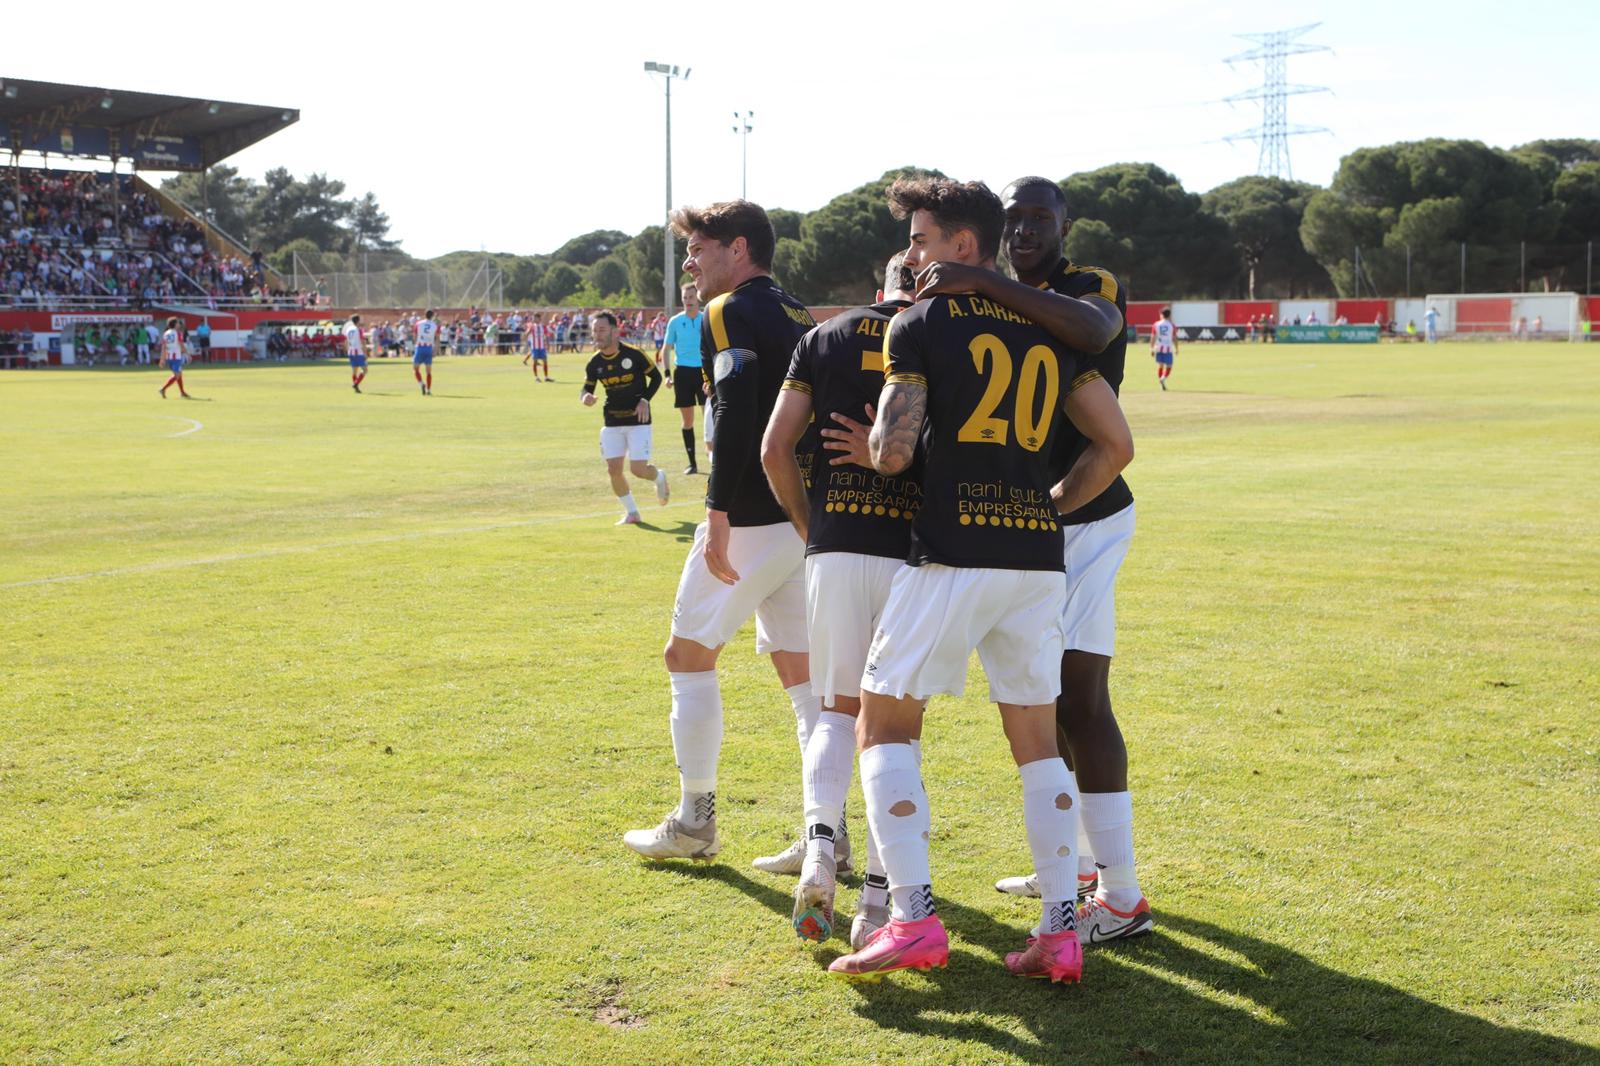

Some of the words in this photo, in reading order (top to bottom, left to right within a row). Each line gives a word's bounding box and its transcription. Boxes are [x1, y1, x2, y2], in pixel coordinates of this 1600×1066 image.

[948, 298, 969, 318] A.
[969, 297, 1033, 325] CARA
[958, 333, 1060, 452] 20
[829, 471, 867, 486] nani
[959, 479, 1002, 498] nani
[827, 489, 920, 511] EMPRESARIA
[959, 500, 1055, 521] EMPRESARIAL
